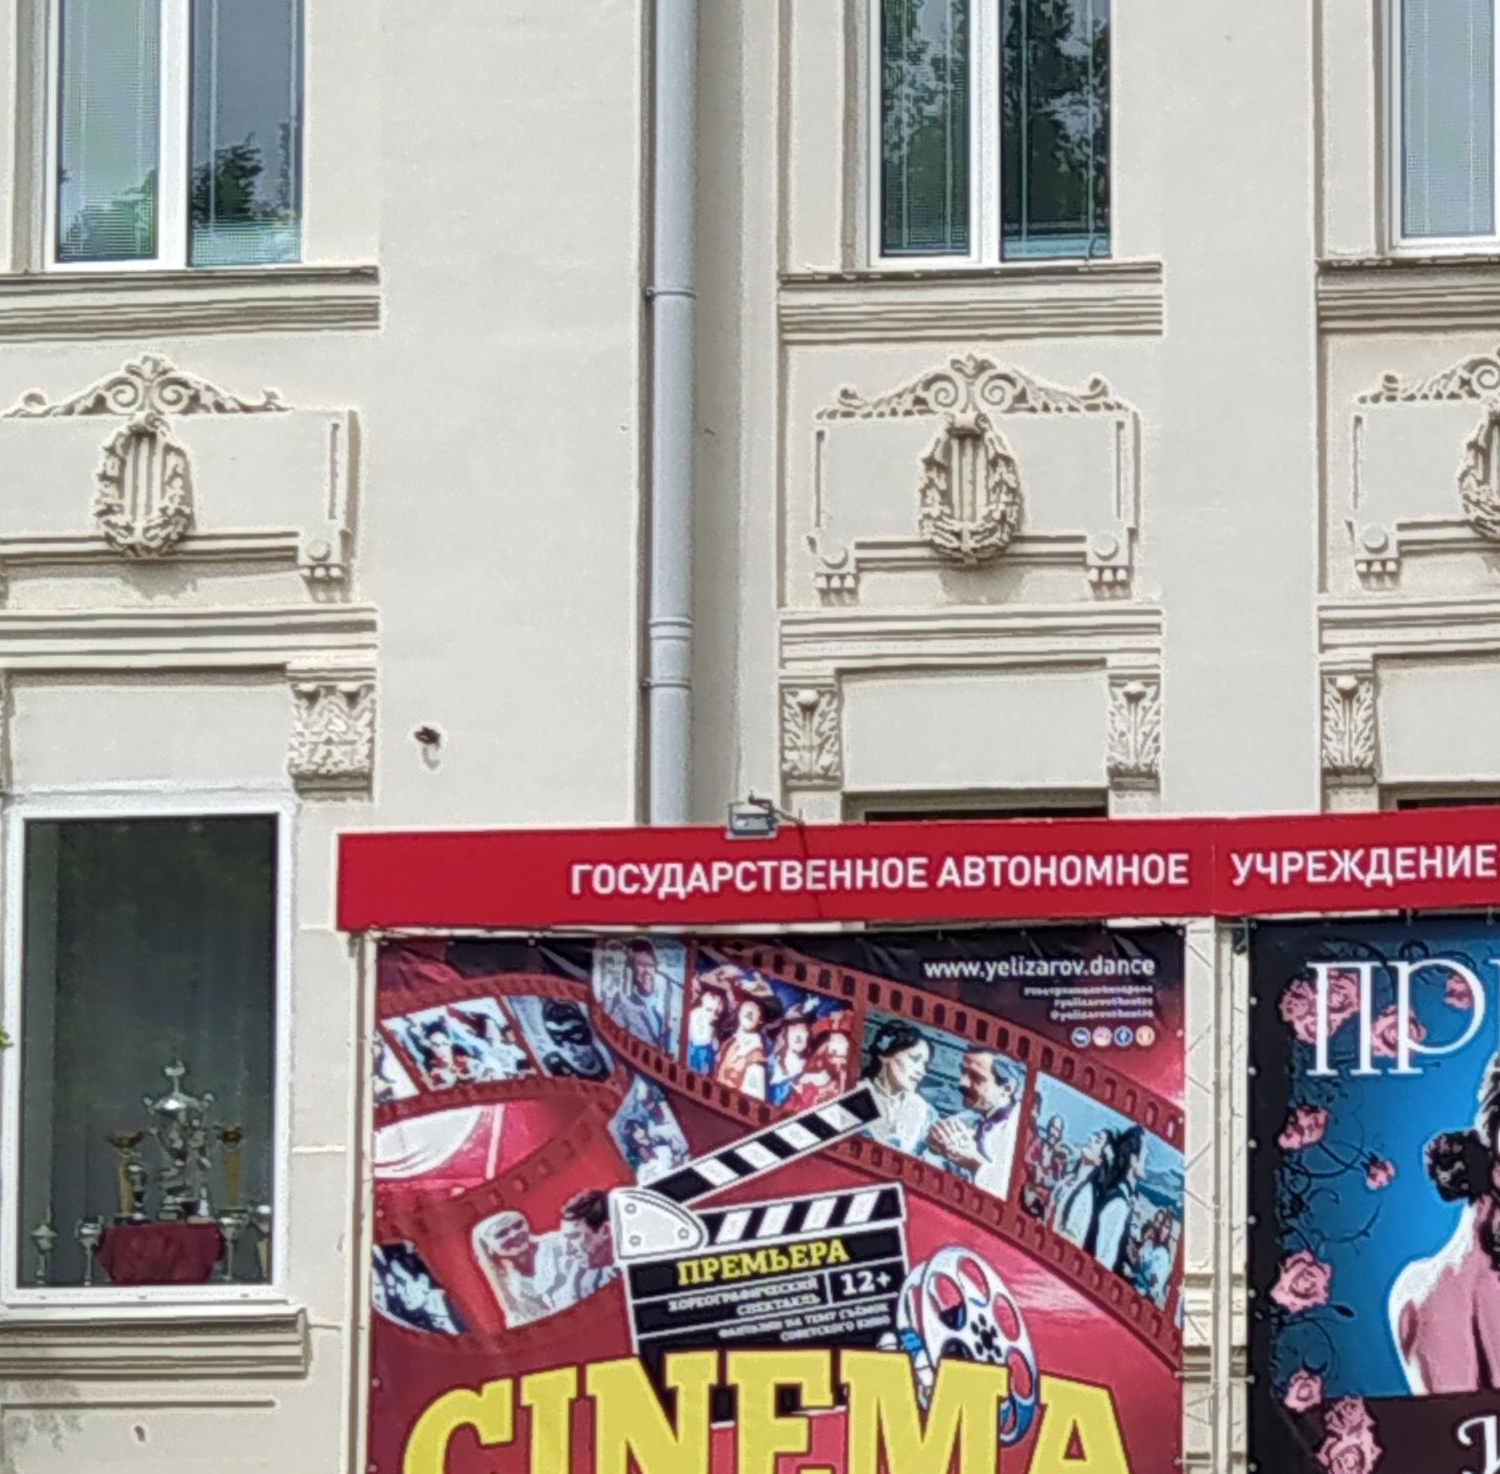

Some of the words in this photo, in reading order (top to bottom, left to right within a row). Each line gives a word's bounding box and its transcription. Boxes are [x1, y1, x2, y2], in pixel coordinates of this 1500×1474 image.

[569, 856, 927, 898] ГОСУДАРСТВЕННОЕ
[937, 853, 1190, 889] АВТОНОМНОЕ
[1229, 845, 1497, 890] УЧРЕЖДЕНИЕ
[924, 954, 1156, 983] www.yelizarov.dance
[676, 1239, 851, 1287] ПРЕМЬЕРА
[839, 1271, 891, 1296] 12+
